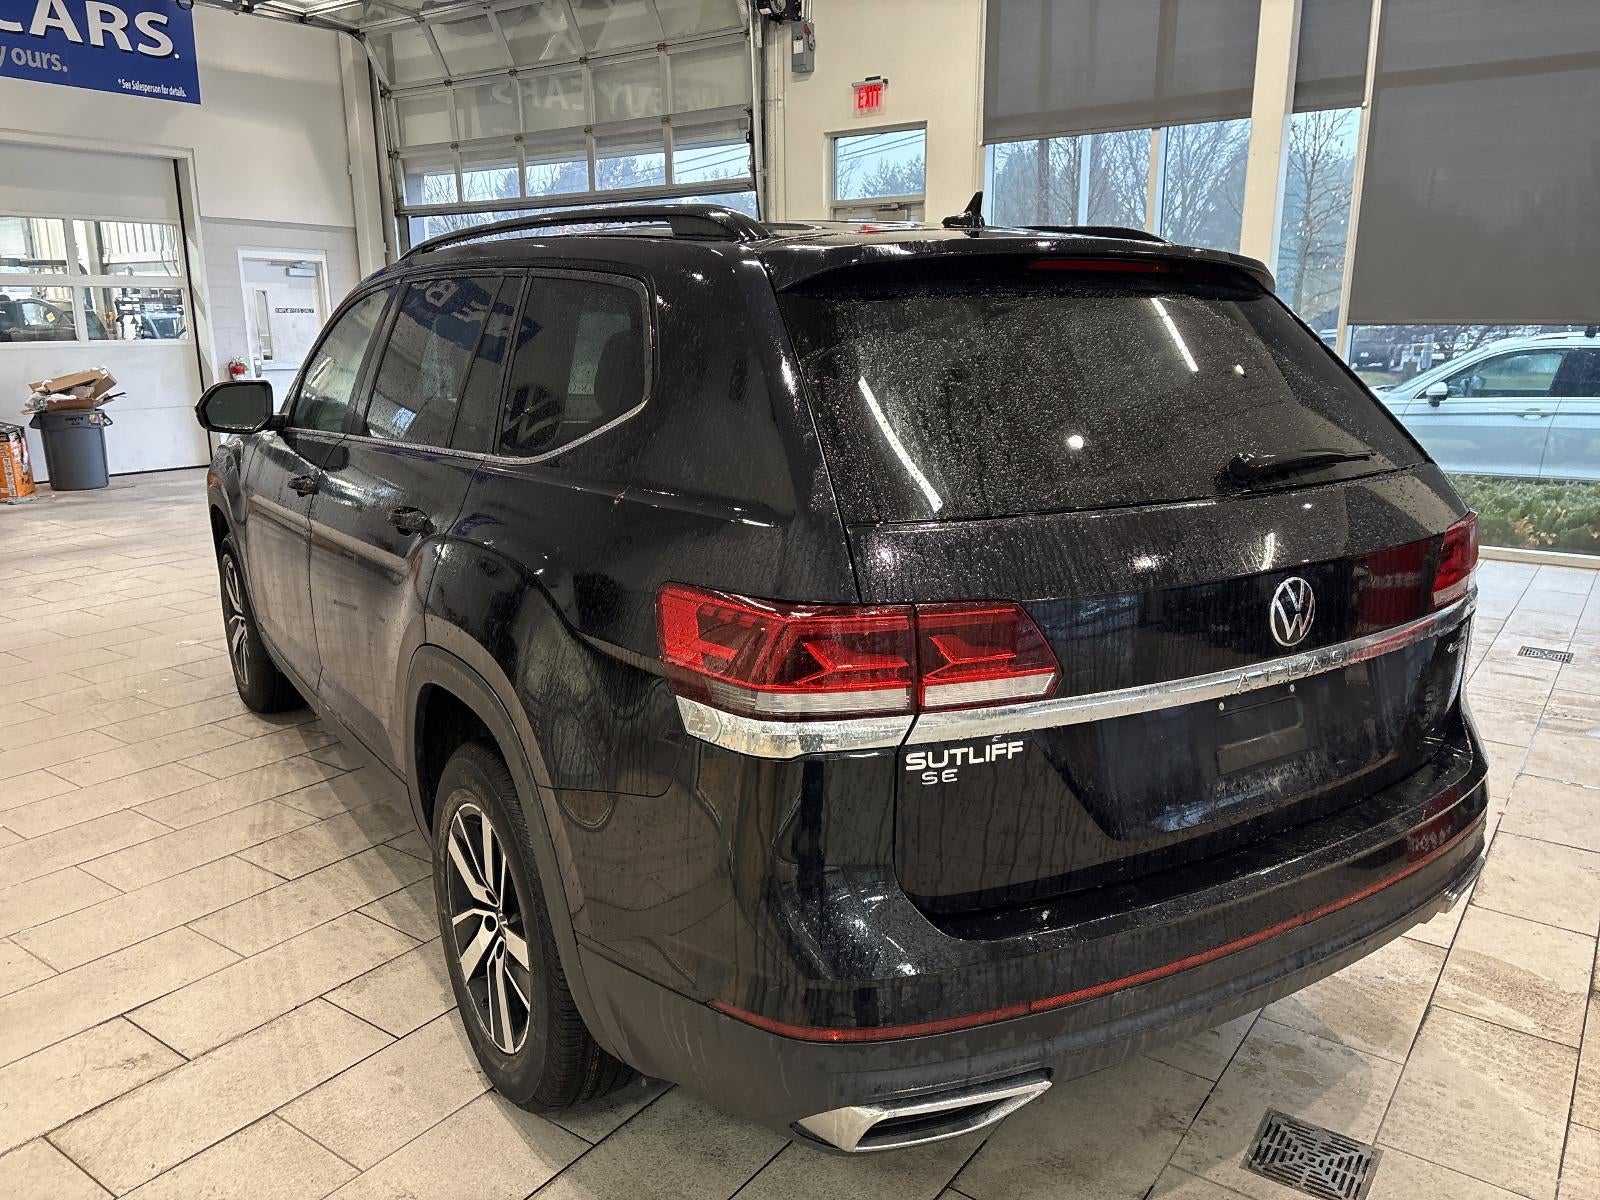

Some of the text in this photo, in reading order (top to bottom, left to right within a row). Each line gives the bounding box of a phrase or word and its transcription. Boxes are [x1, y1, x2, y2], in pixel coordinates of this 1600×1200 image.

[11, 47, 68, 72] ours.
[132, 80, 161, 94] Salesperson
[857, 85, 880, 108] EXIT
[1236, 650, 1343, 689] ATLAS
[905, 741, 1023, 771] SUTLIFF
[921, 769, 958, 785] SE
